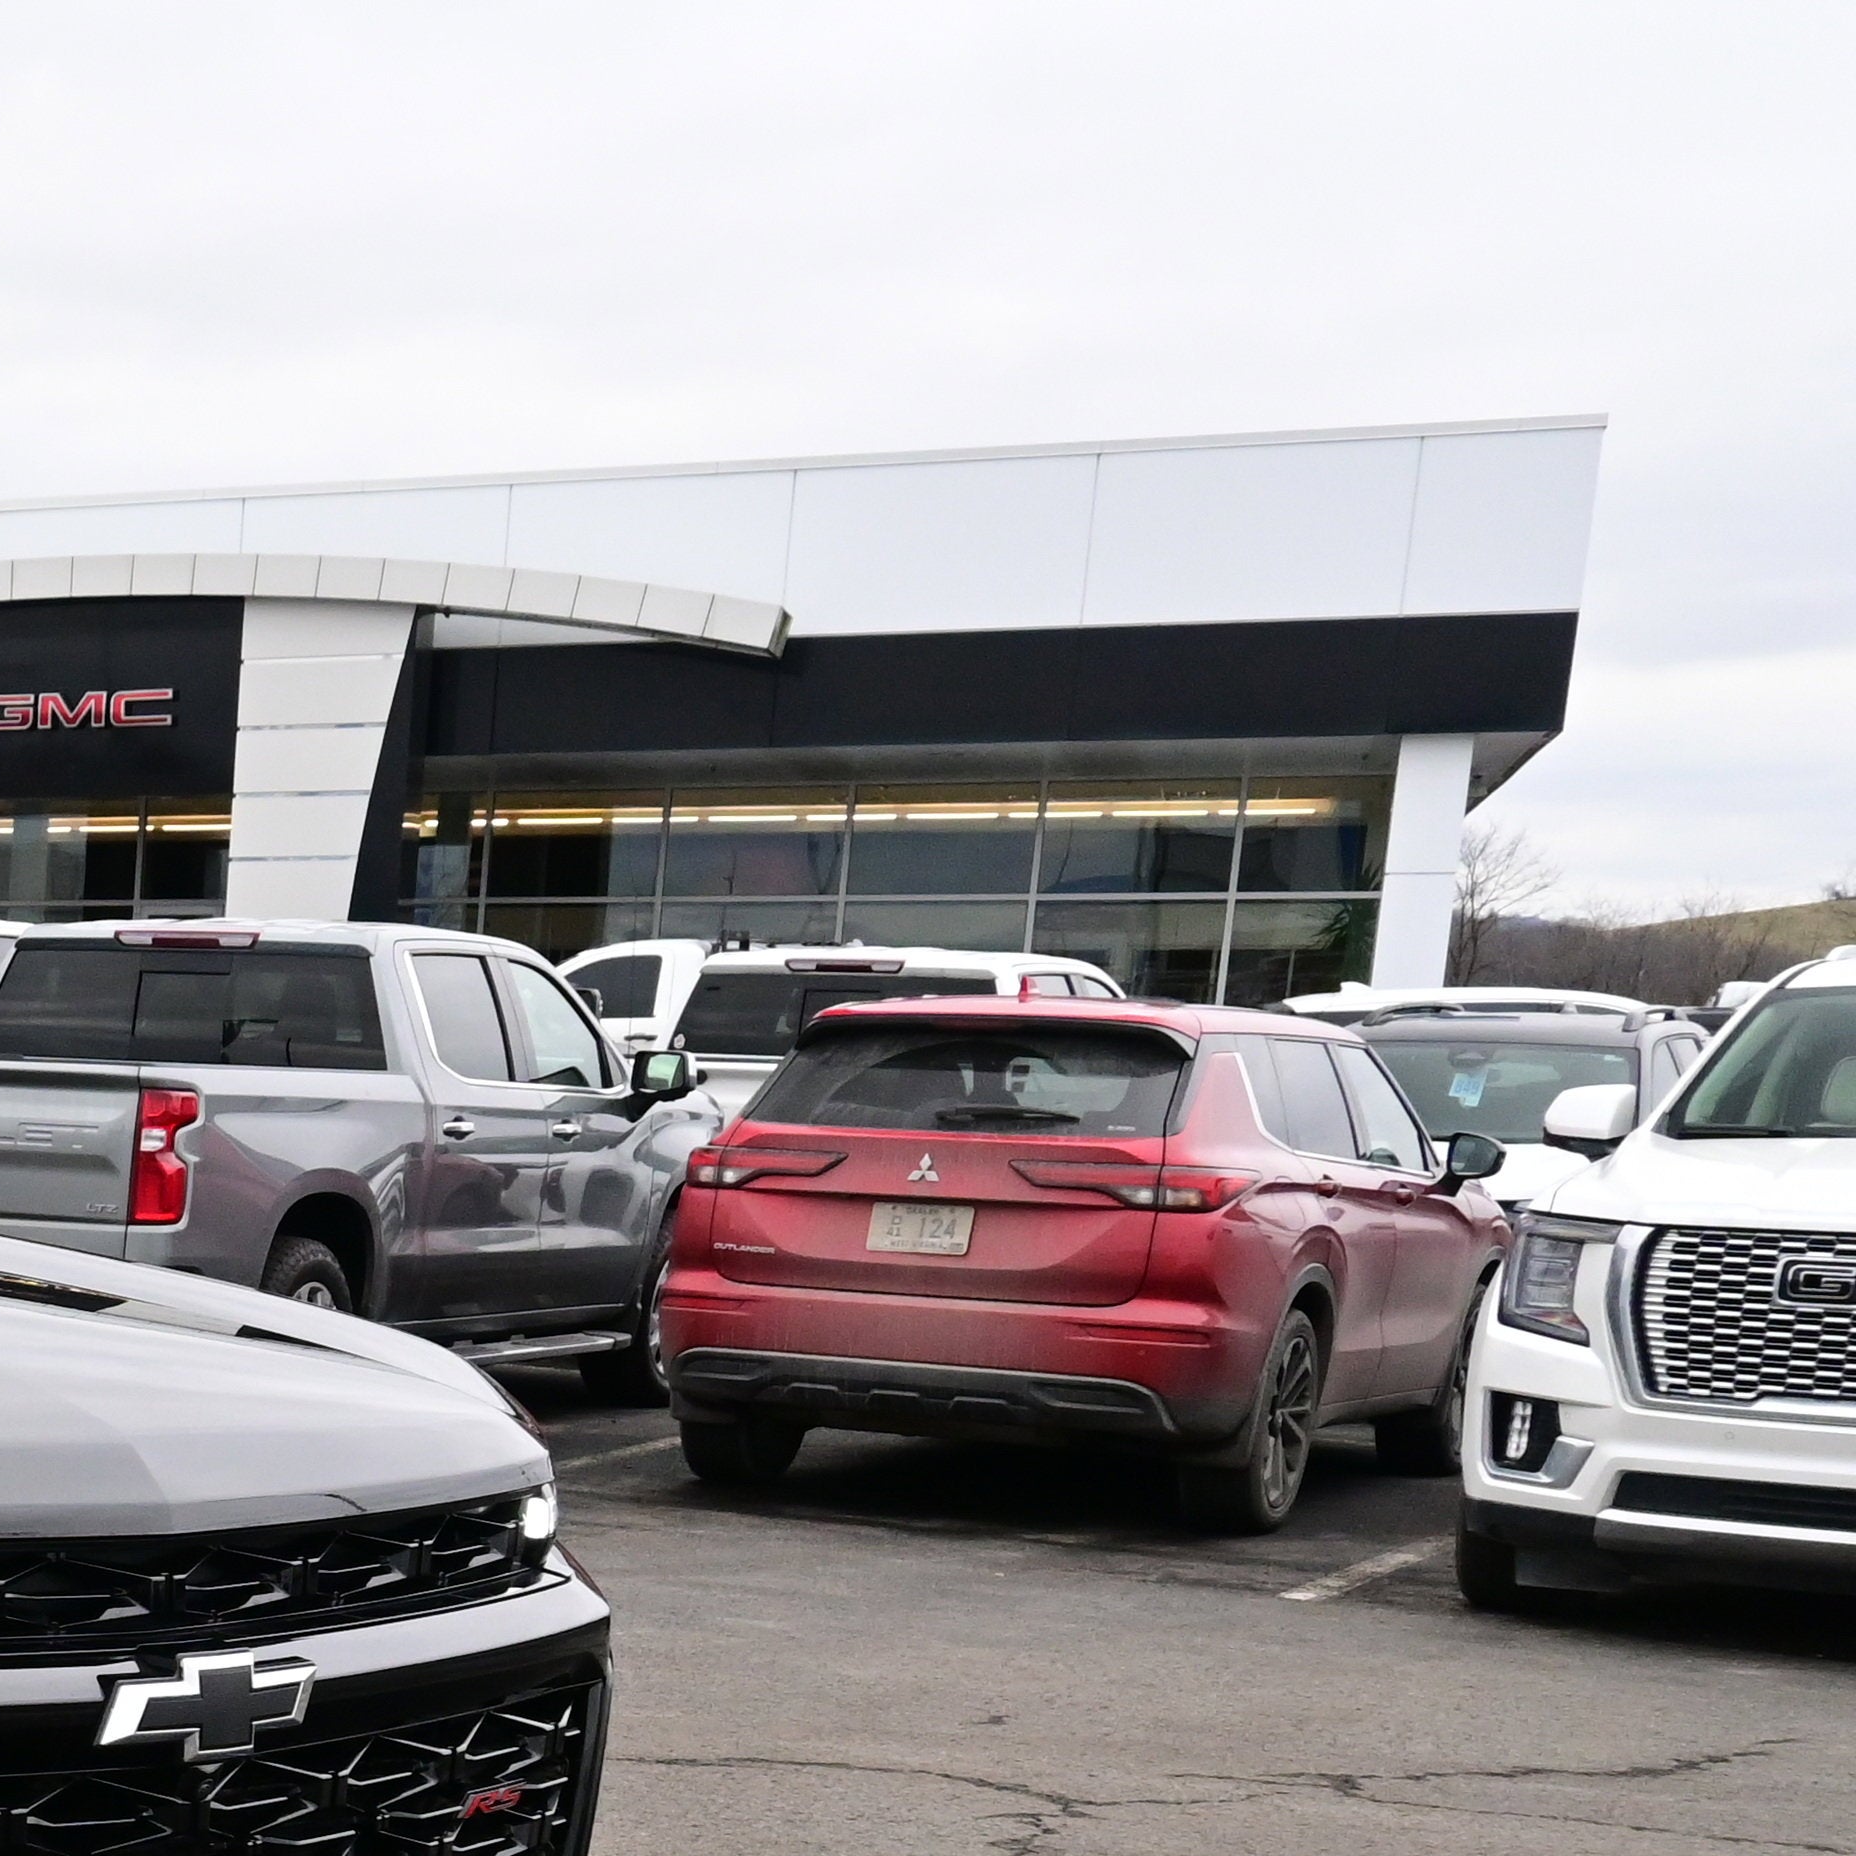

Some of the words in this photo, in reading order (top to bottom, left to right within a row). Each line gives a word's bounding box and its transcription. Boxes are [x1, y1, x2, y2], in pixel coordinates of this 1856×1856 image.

[86, 1202, 119, 1213] LTZ
[919, 1217, 957, 1239] 124
[713, 1242, 776, 1255] OUTLANDER
[460, 1784, 524, 1819] RS
